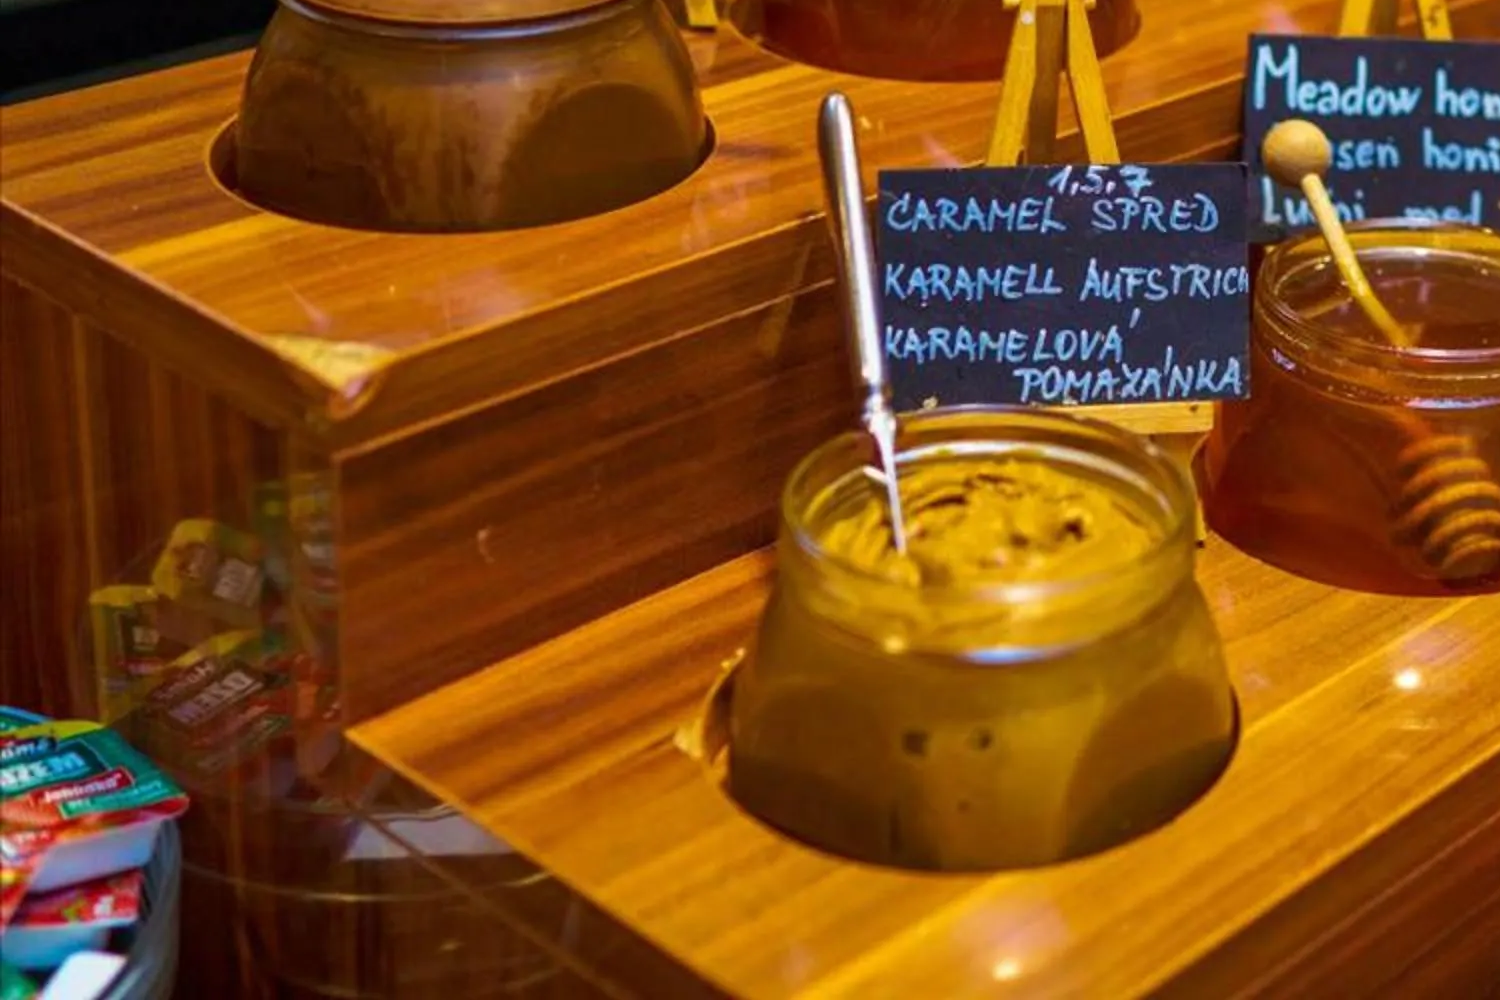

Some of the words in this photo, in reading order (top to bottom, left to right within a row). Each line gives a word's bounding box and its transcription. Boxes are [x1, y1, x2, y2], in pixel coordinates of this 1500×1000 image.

[1253, 43, 1422, 116] Meadow
[886, 192, 1067, 234] CARAMEL
[1091, 193, 1219, 232] SPRED
[884, 262, 1064, 302] KARAMELL
